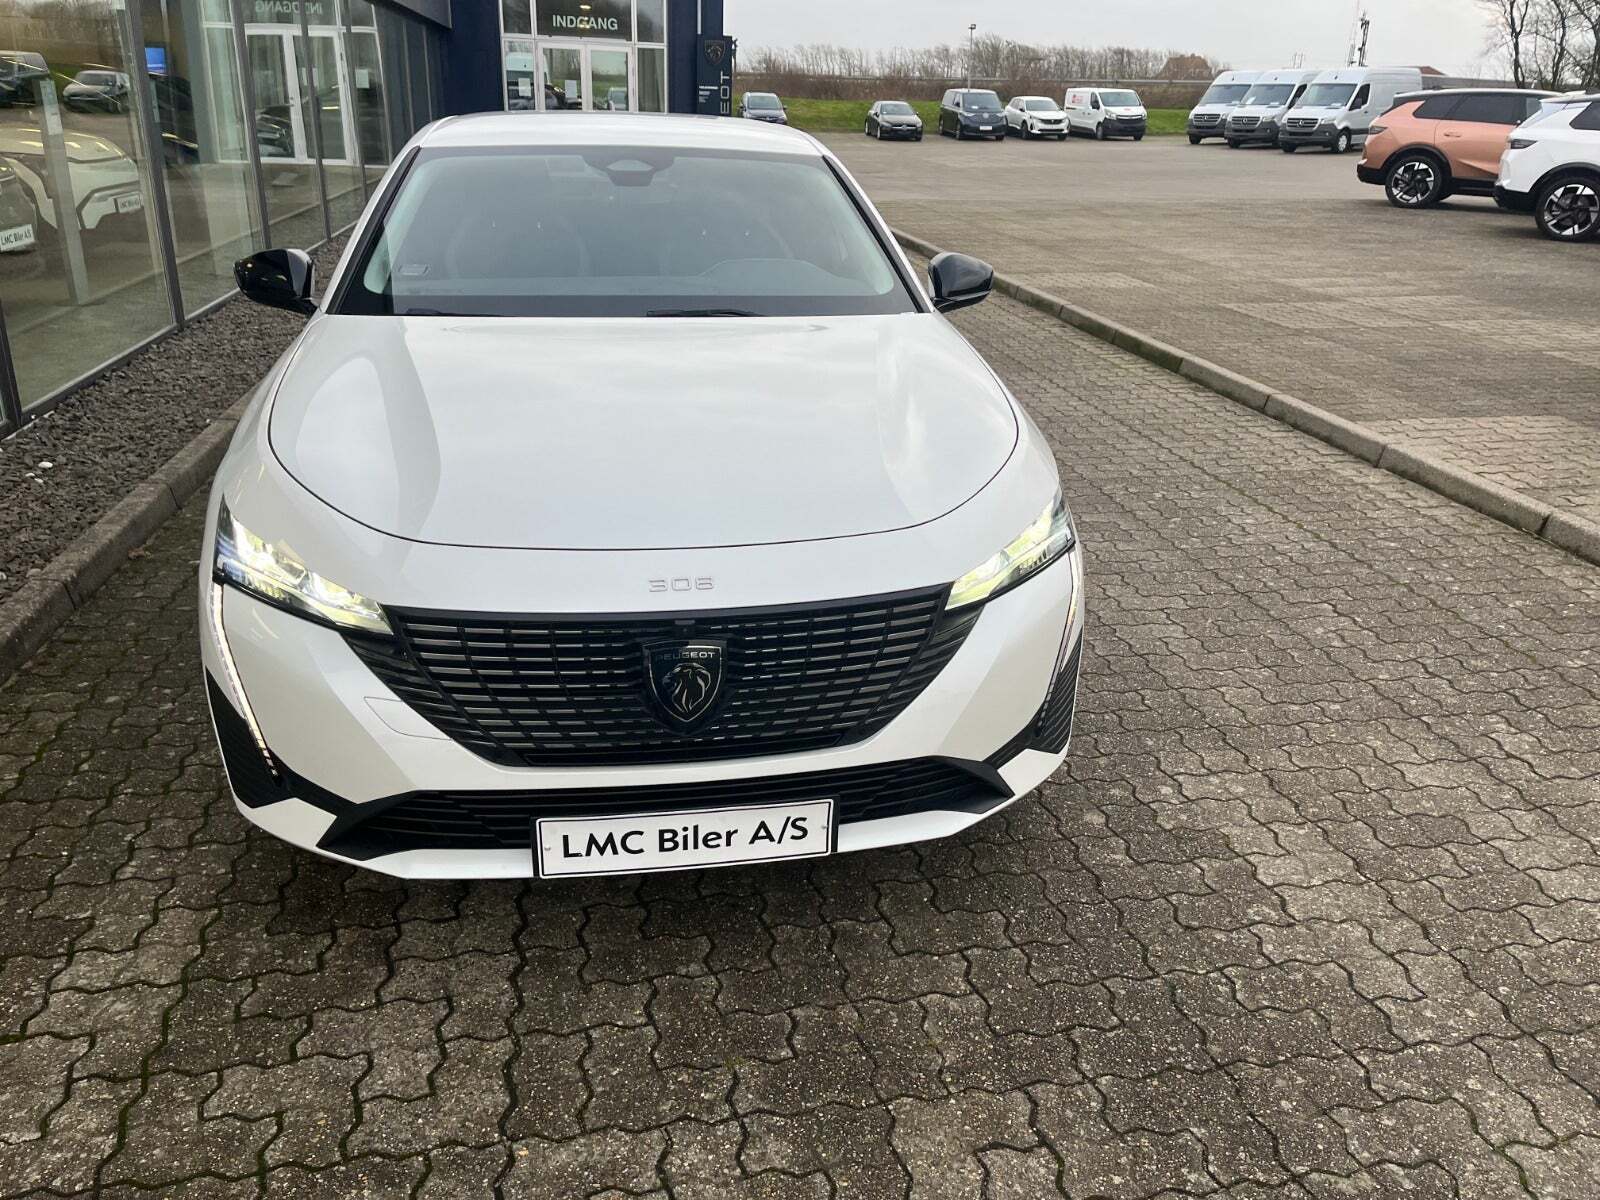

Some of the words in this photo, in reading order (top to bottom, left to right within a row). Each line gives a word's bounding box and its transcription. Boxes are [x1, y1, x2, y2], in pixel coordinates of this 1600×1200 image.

[552, 14, 618, 30] INDGANG
[562, 830, 645, 858] LMC
[658, 824, 739, 853] Biler
[748, 816, 809, 845] A/S
